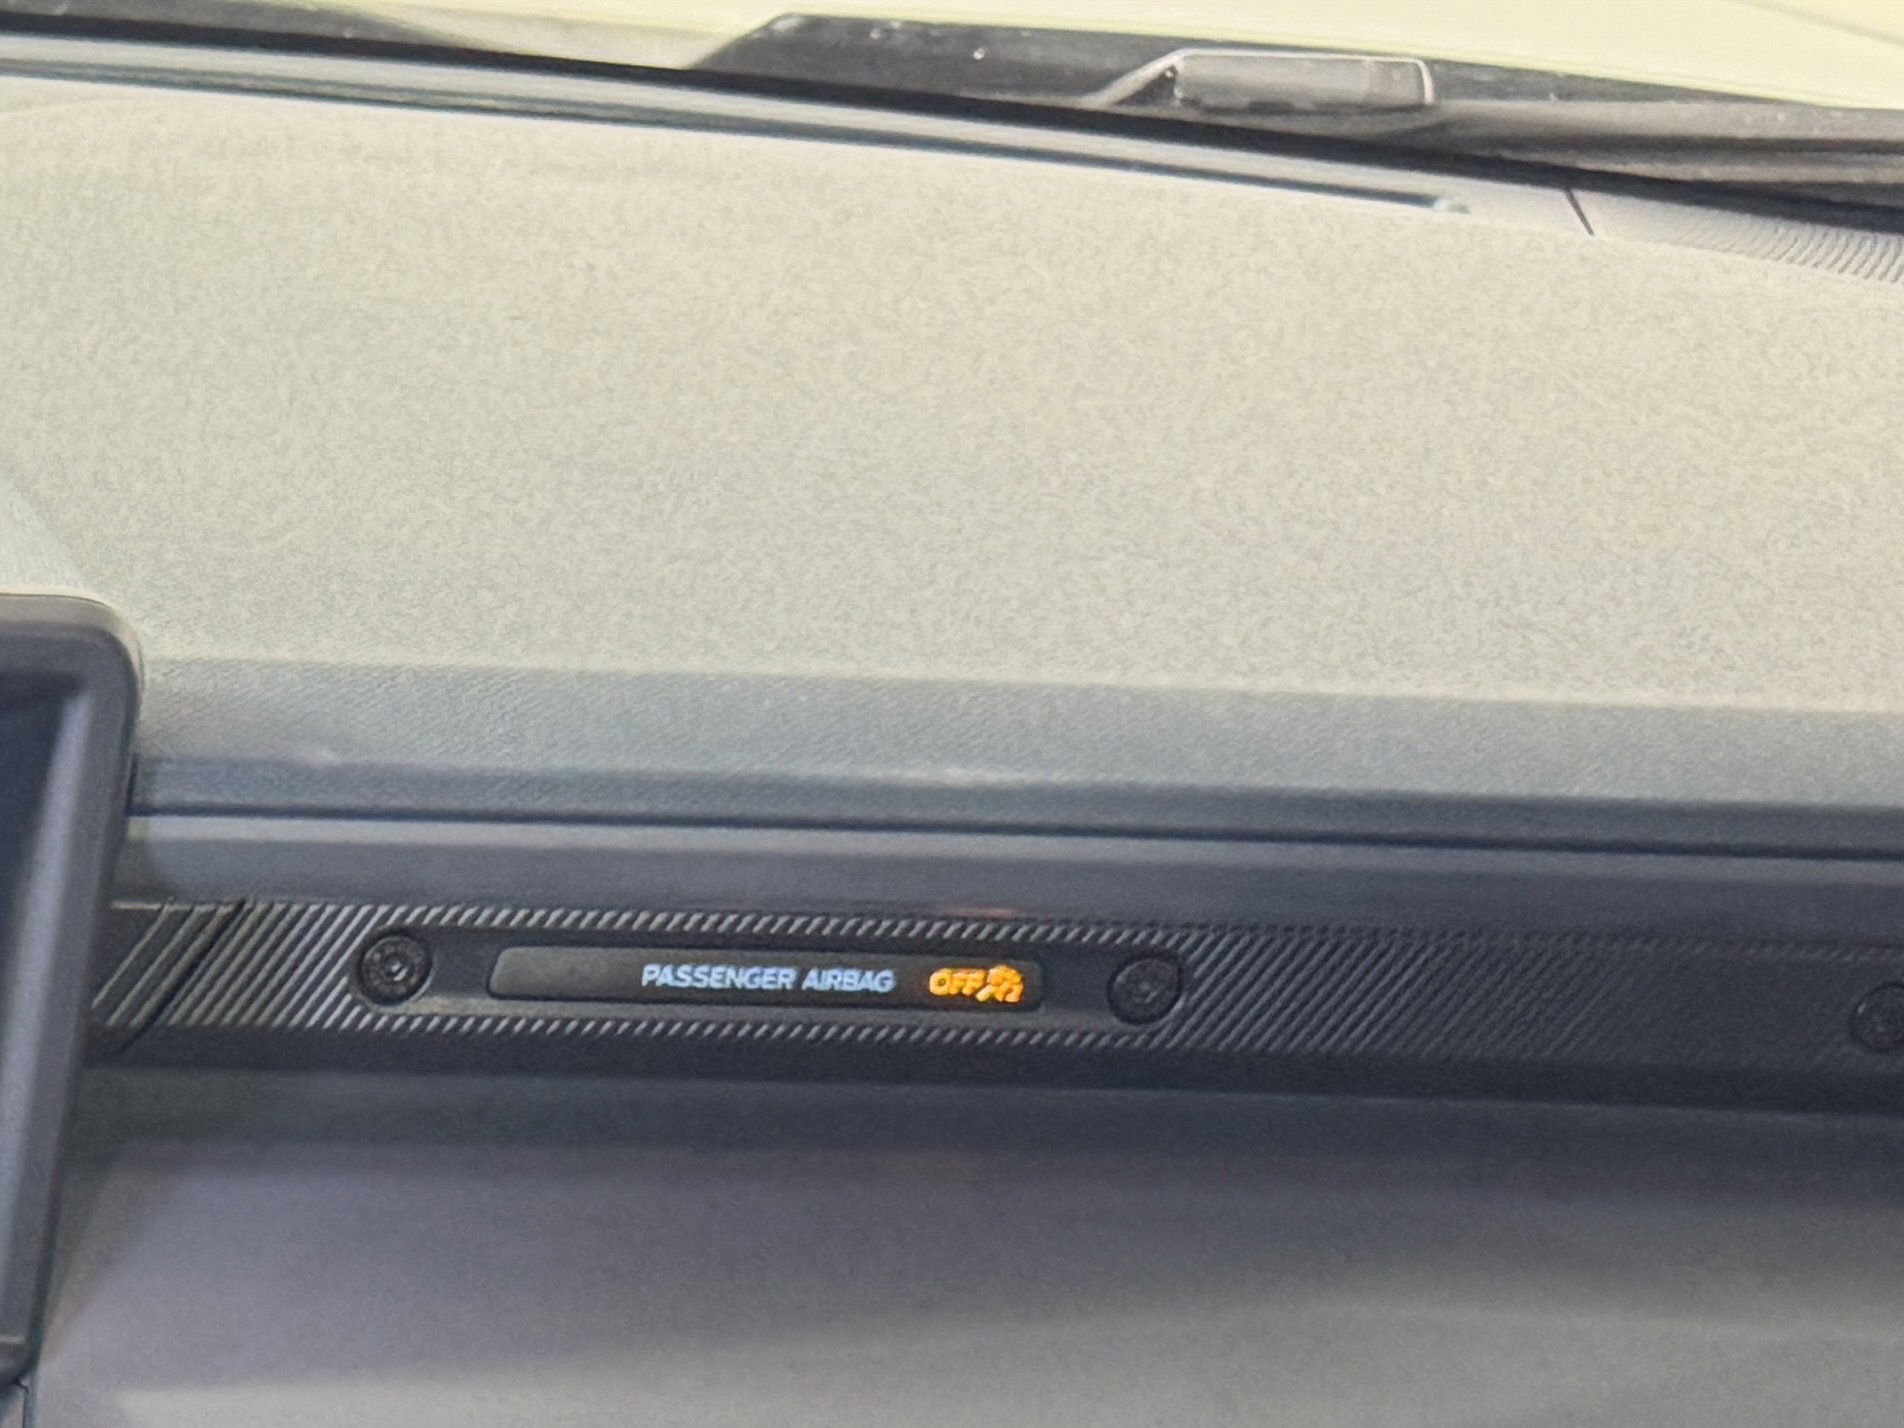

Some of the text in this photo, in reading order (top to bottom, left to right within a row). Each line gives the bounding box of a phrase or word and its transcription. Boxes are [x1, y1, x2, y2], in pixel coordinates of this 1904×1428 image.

[641, 963, 986, 996] PASSENGER AIRBAG OFF
